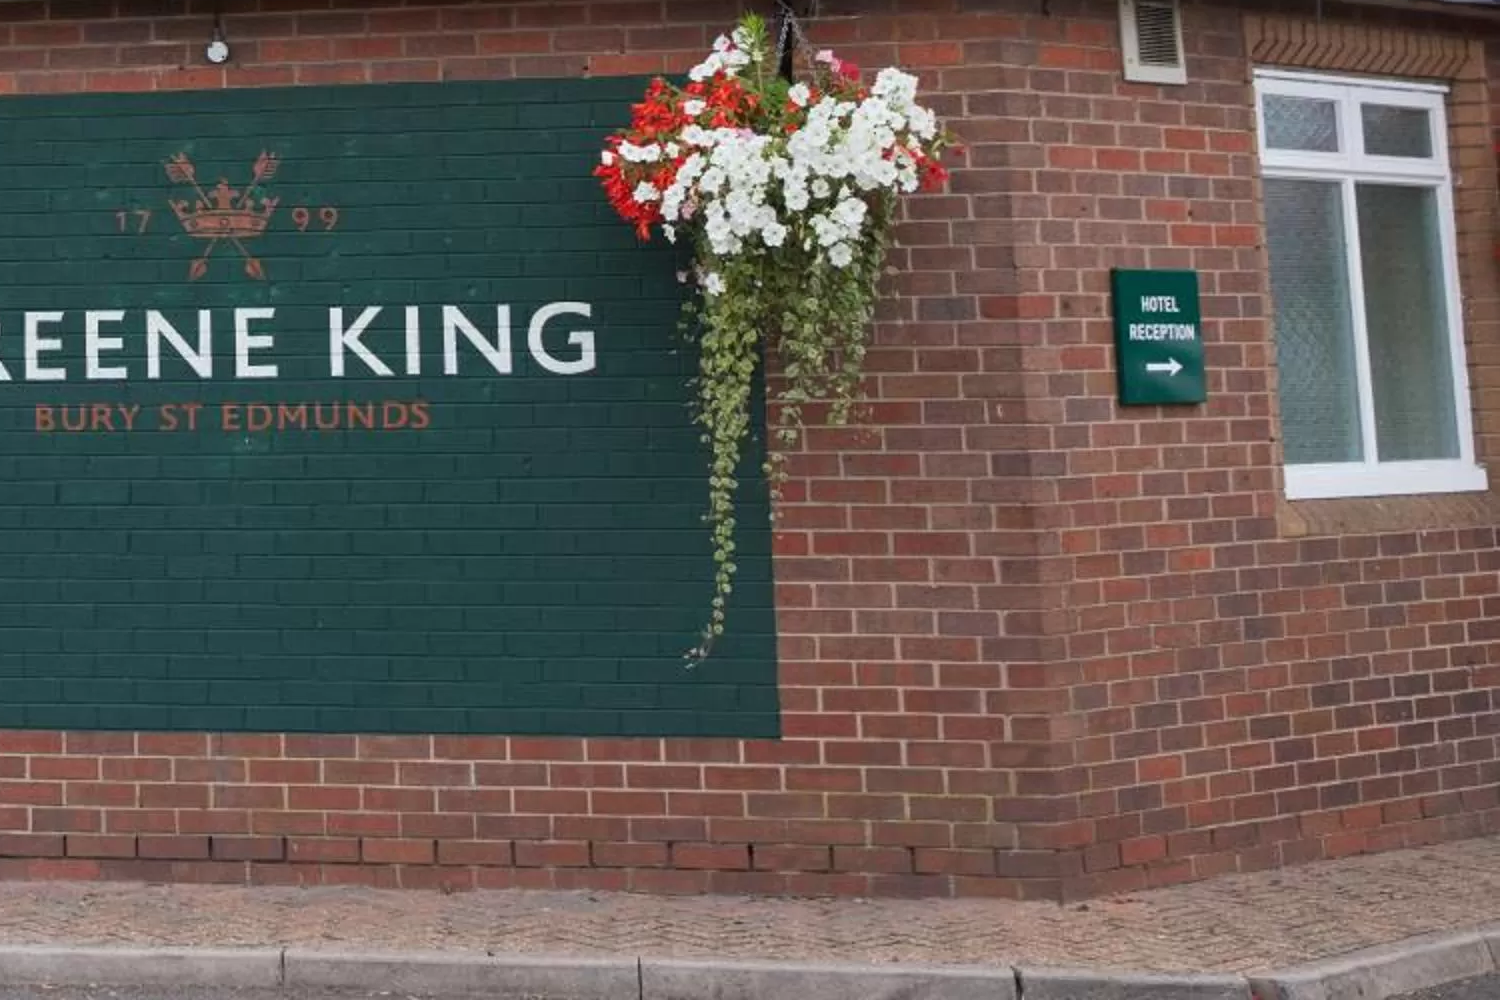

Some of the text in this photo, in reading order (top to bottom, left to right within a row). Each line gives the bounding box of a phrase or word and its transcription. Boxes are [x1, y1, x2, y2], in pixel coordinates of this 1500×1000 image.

[116, 206, 338, 233] 17 99
[1140, 295, 1181, 313] HOTEL
[328, 301, 598, 378] KING
[1129, 323, 1196, 341] RECEPTION
[34, 400, 431, 432] BURY ST EDMUNDS
